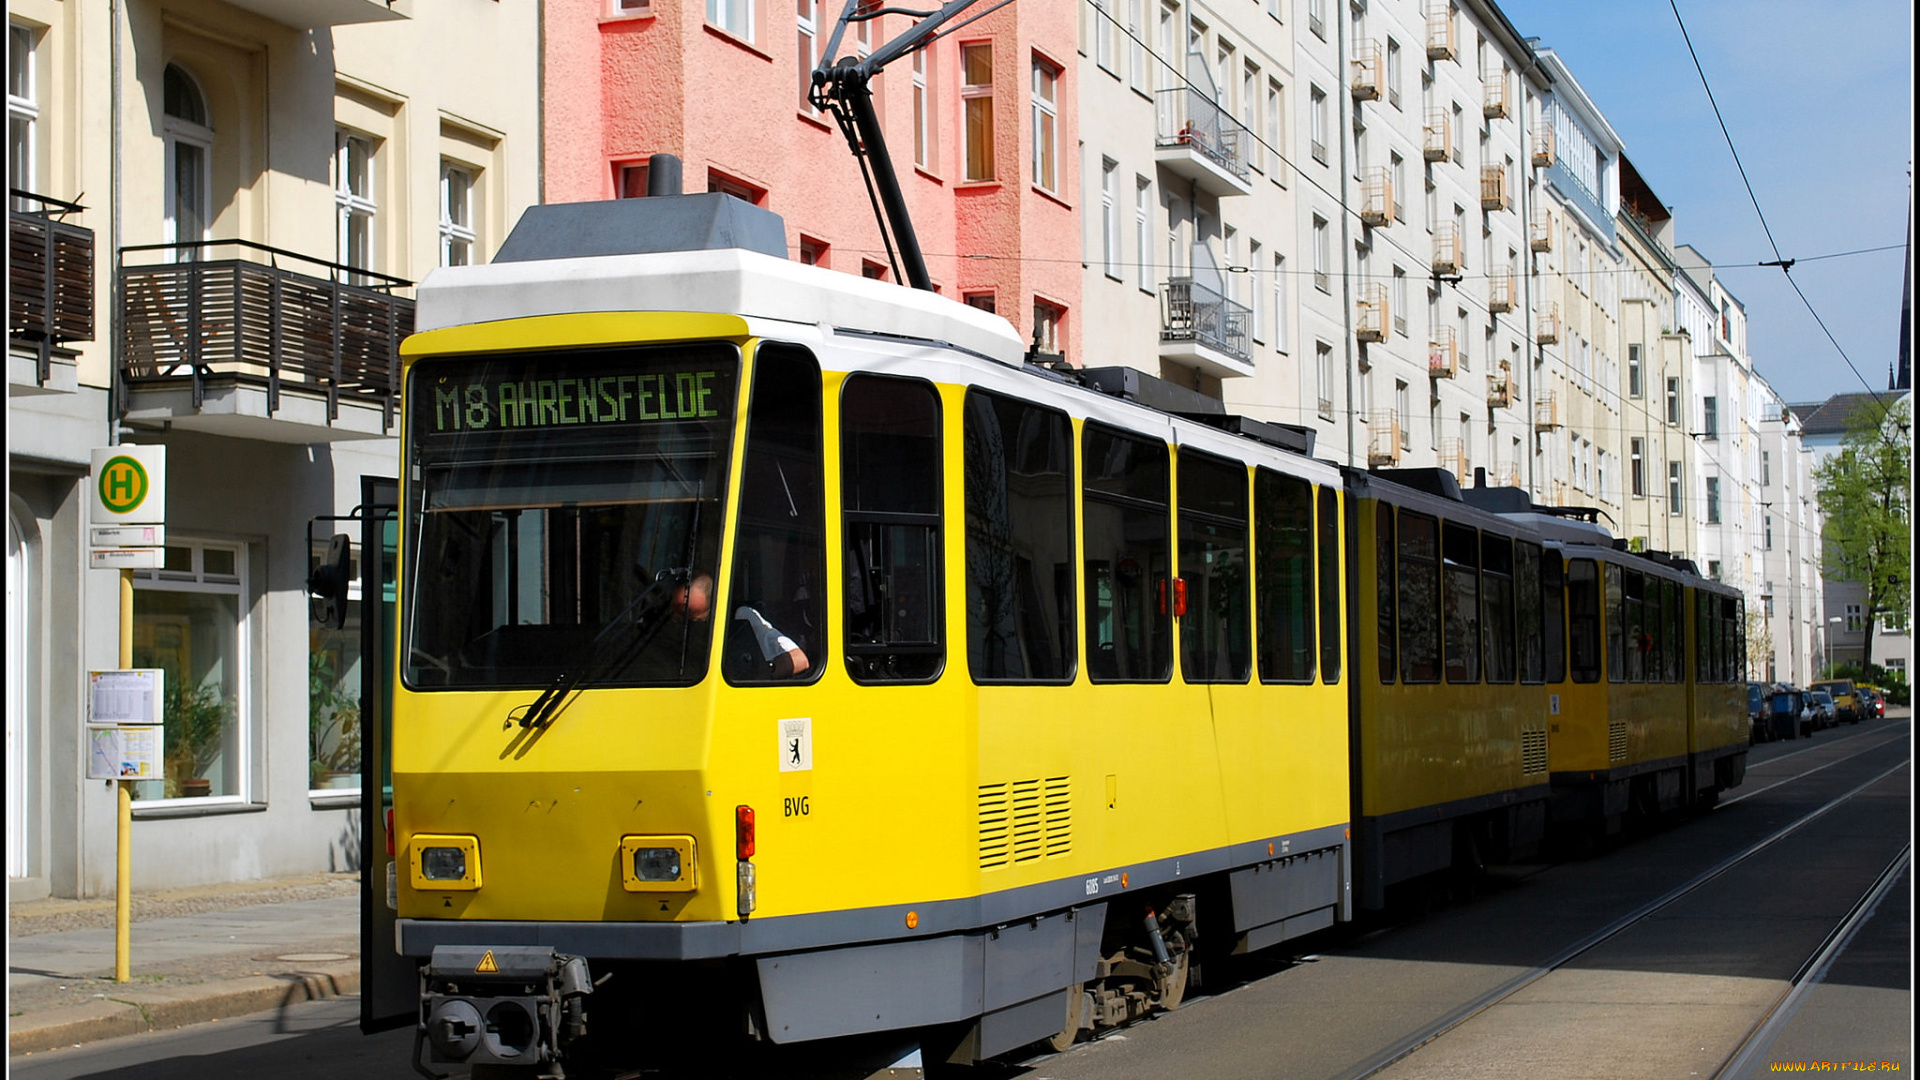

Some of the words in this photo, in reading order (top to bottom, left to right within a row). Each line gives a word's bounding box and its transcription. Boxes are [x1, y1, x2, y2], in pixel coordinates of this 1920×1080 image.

[499, 371, 718, 427] AHRENSFELDE
[110, 469, 133, 500] H
[784, 796, 809, 817] BVG
